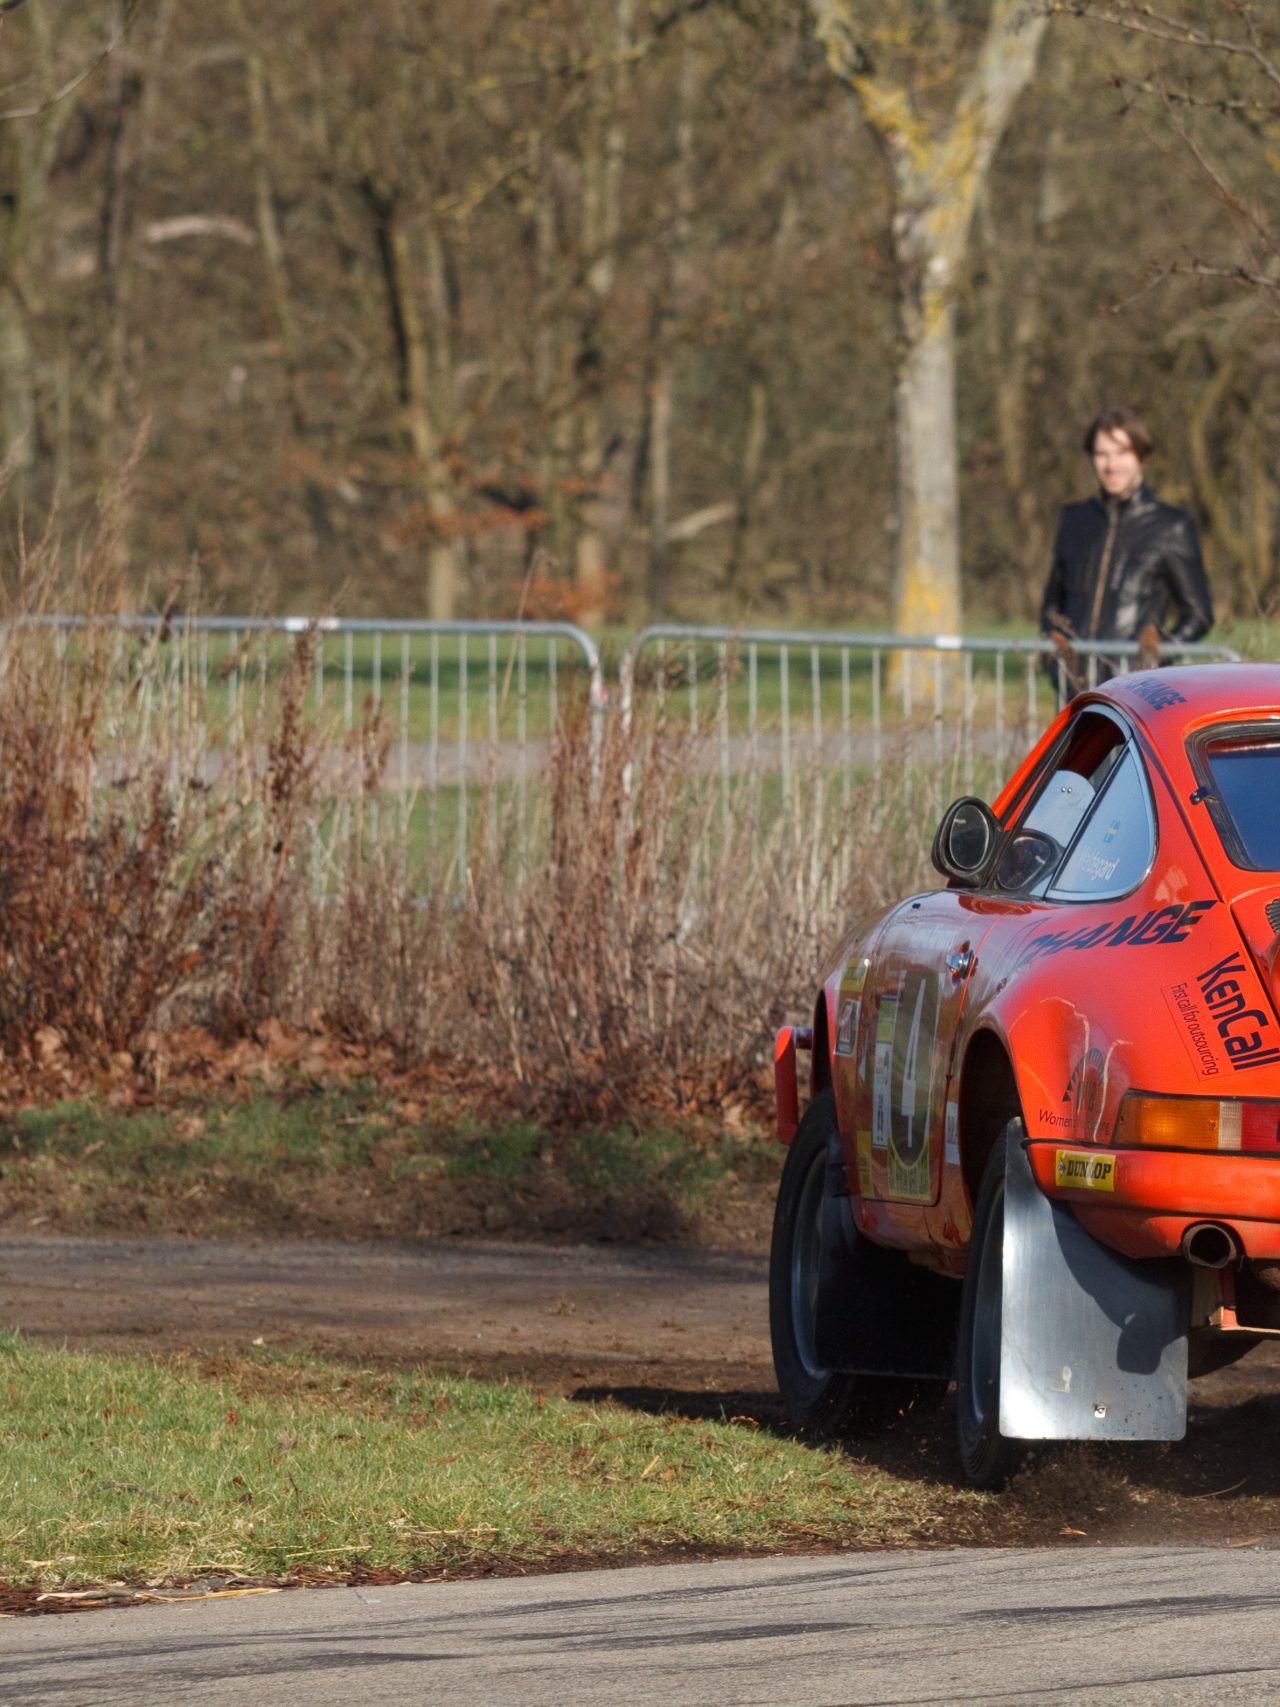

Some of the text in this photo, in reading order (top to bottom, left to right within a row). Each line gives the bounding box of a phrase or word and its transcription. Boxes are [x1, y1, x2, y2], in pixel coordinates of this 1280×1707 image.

[1016, 900, 1218, 970] CHANGE
[1171, 982, 1220, 1076] First call for outsourcing
